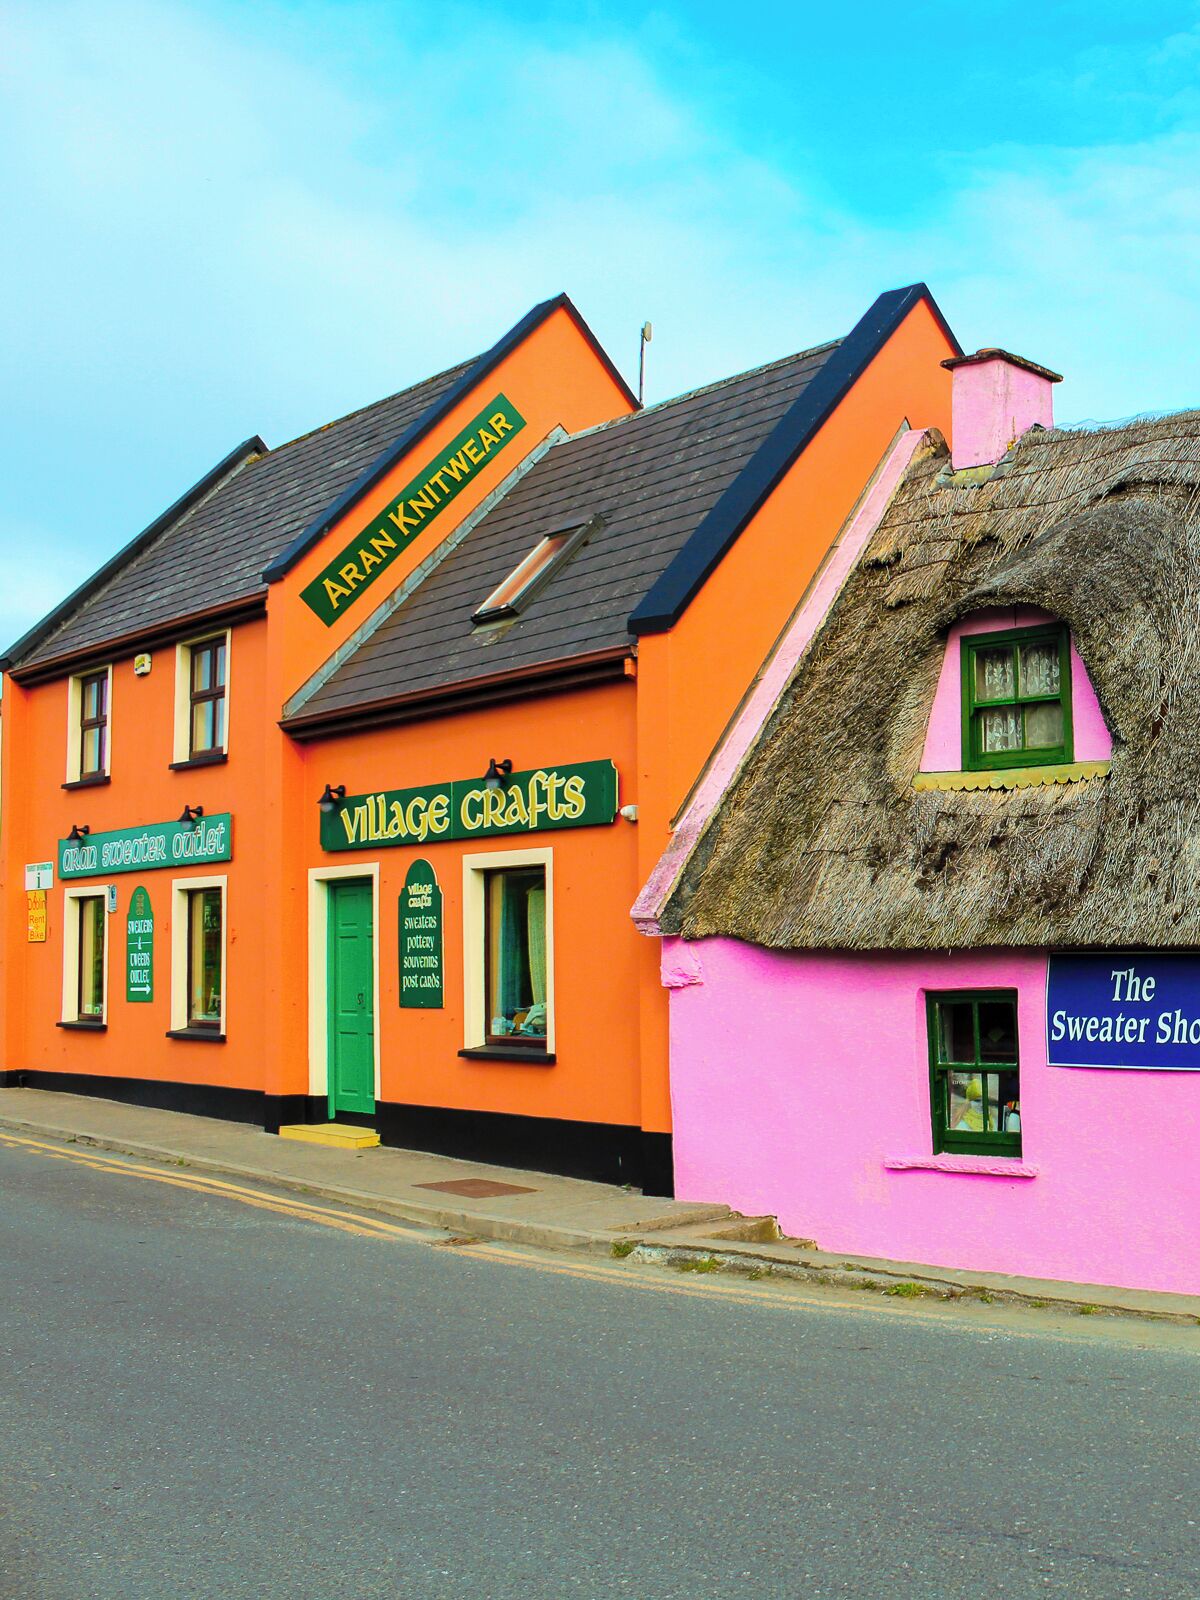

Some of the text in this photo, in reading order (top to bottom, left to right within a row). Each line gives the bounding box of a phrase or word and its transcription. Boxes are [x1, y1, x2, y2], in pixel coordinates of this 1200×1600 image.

[322, 412, 514, 610] ARAN KNITWEAR
[173, 821, 225, 858] outlet
[1111, 967, 1156, 1002] The
[1051, 1010, 1150, 1043] Sweater
